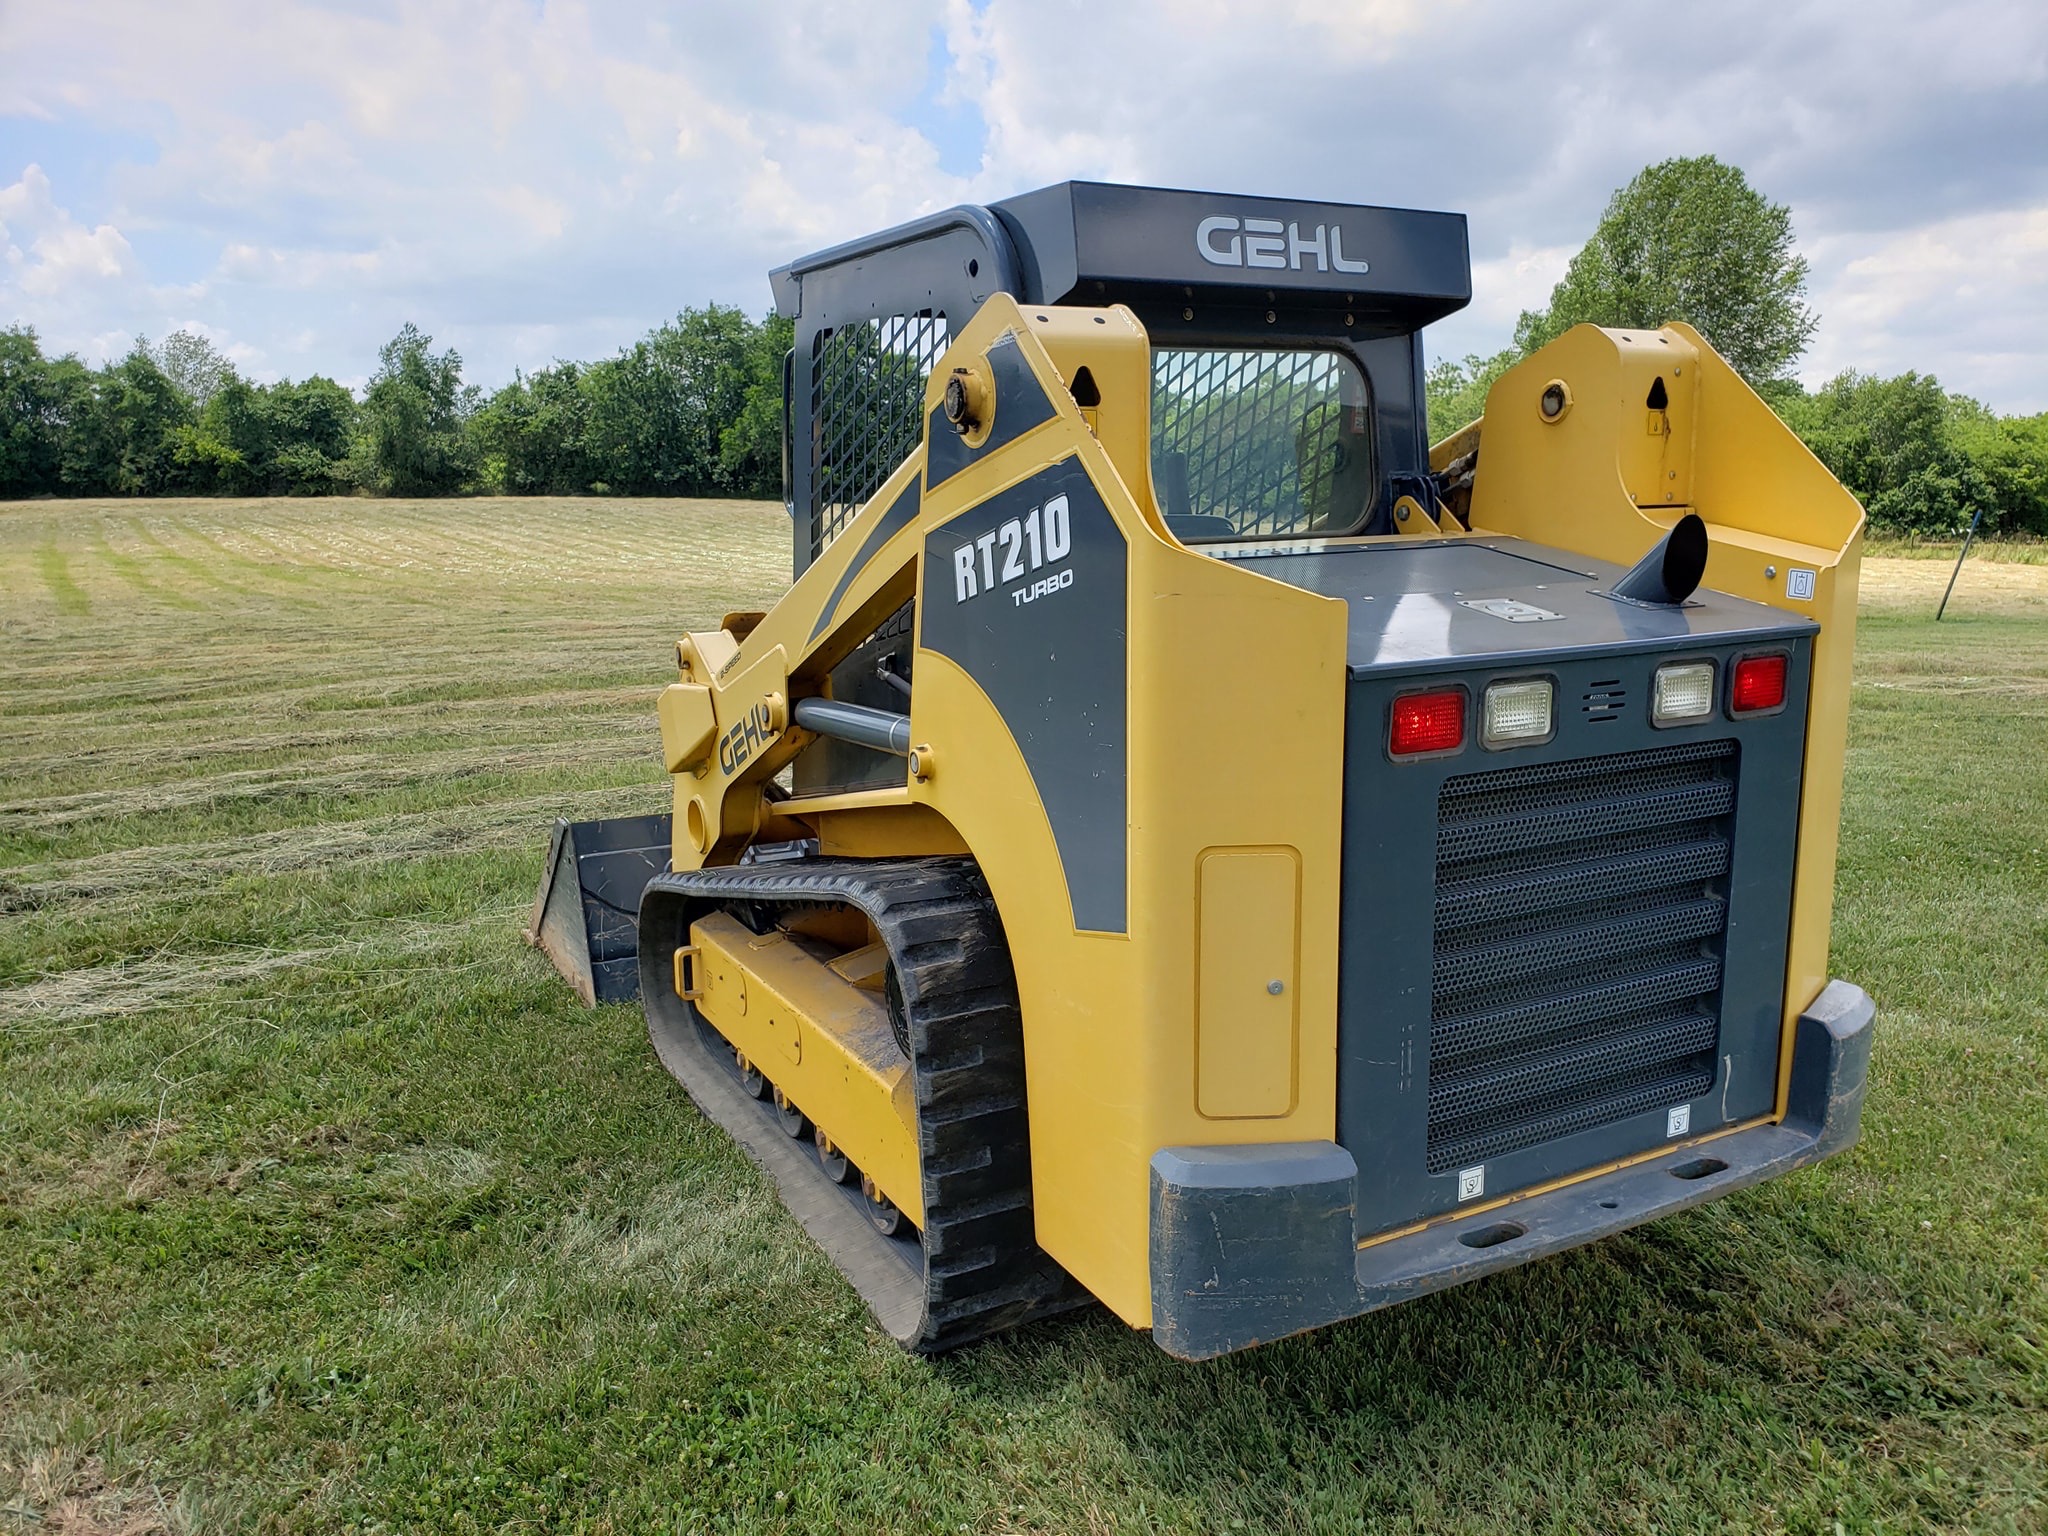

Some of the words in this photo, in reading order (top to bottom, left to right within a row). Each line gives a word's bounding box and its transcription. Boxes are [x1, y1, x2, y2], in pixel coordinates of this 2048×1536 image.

[1196, 215, 1370, 274] GEHL
[953, 492, 1072, 605] RT210
[1011, 568, 1073, 606] TURBO
